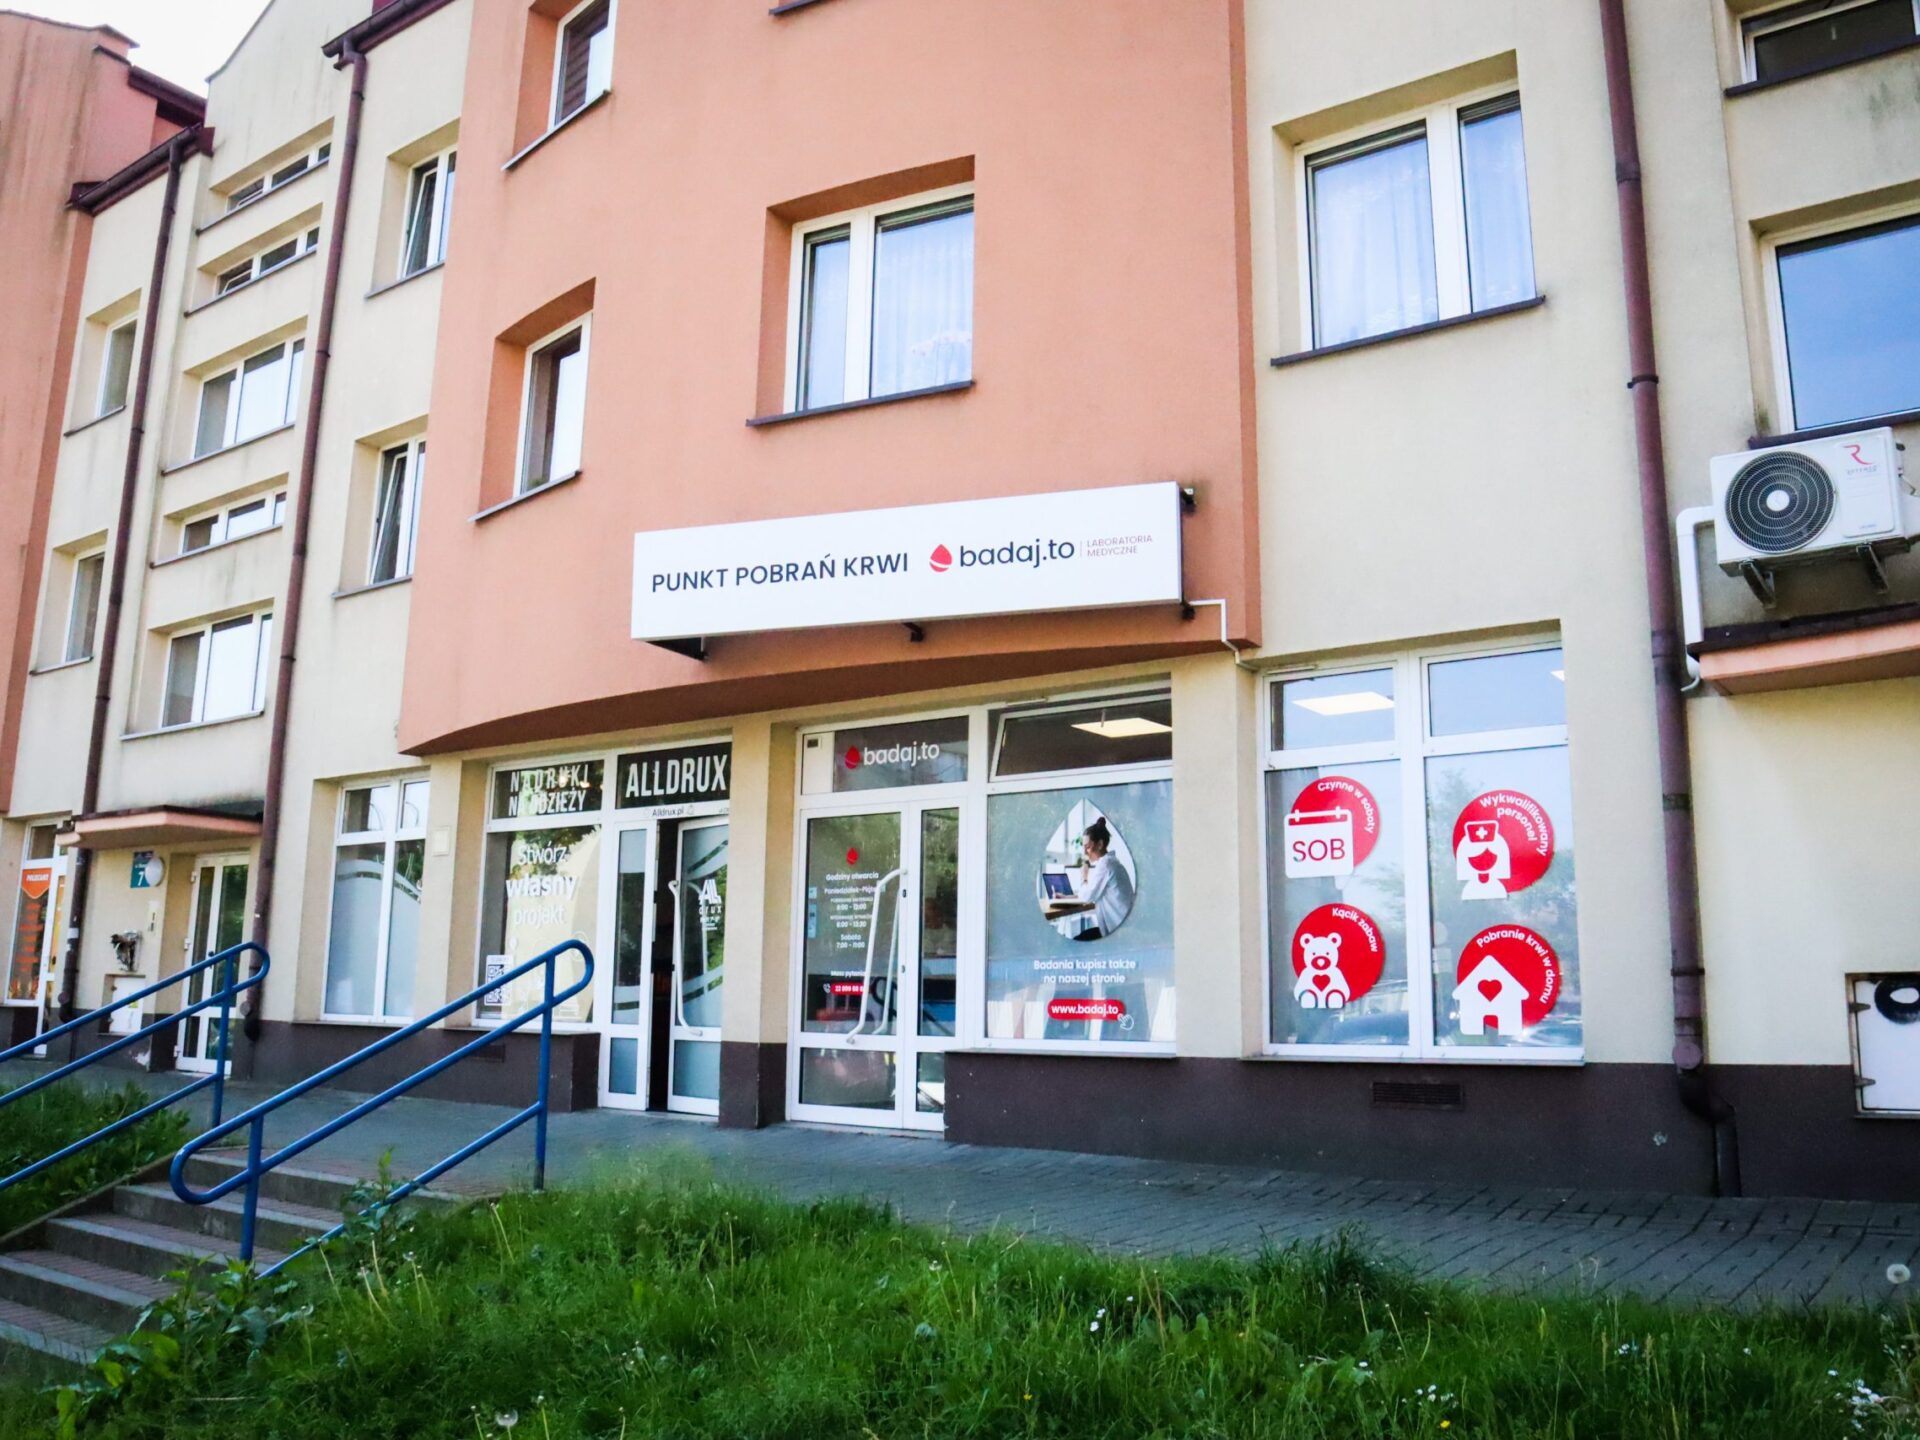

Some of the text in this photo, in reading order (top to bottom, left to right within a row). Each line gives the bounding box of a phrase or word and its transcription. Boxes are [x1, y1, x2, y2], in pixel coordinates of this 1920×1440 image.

[960, 538, 1075, 568] badaj.to
[1087, 535, 1153, 547] LABORATORIA
[1087, 546, 1138, 557] MEDYCZNE
[652, 552, 908, 593] PUNKT POBRAŃ KRWI
[864, 740, 940, 767] badaj.to
[510, 764, 588, 792] NADRUKI
[626, 755, 728, 798] ALLDRUX
[1318, 781, 1375, 834] Czynne w soboty
[1480, 793, 1549, 856] Wykwalifikowany
[1496, 807, 1538, 842] personel
[519, 841, 568, 865] Stwórz
[1292, 839, 1345, 862] SOB
[506, 872, 577, 901] własny
[515, 904, 567, 929] projekt
[1332, 907, 1378, 952] Kącik zabaw
[1033, 958, 1136, 972] Badania kupisz także
[1476, 929, 1555, 1004] Pobranie krwi w domu
[1043, 973, 1126, 986] na naszej stronie
[1051, 1004, 1119, 1018] www.badaj.to
